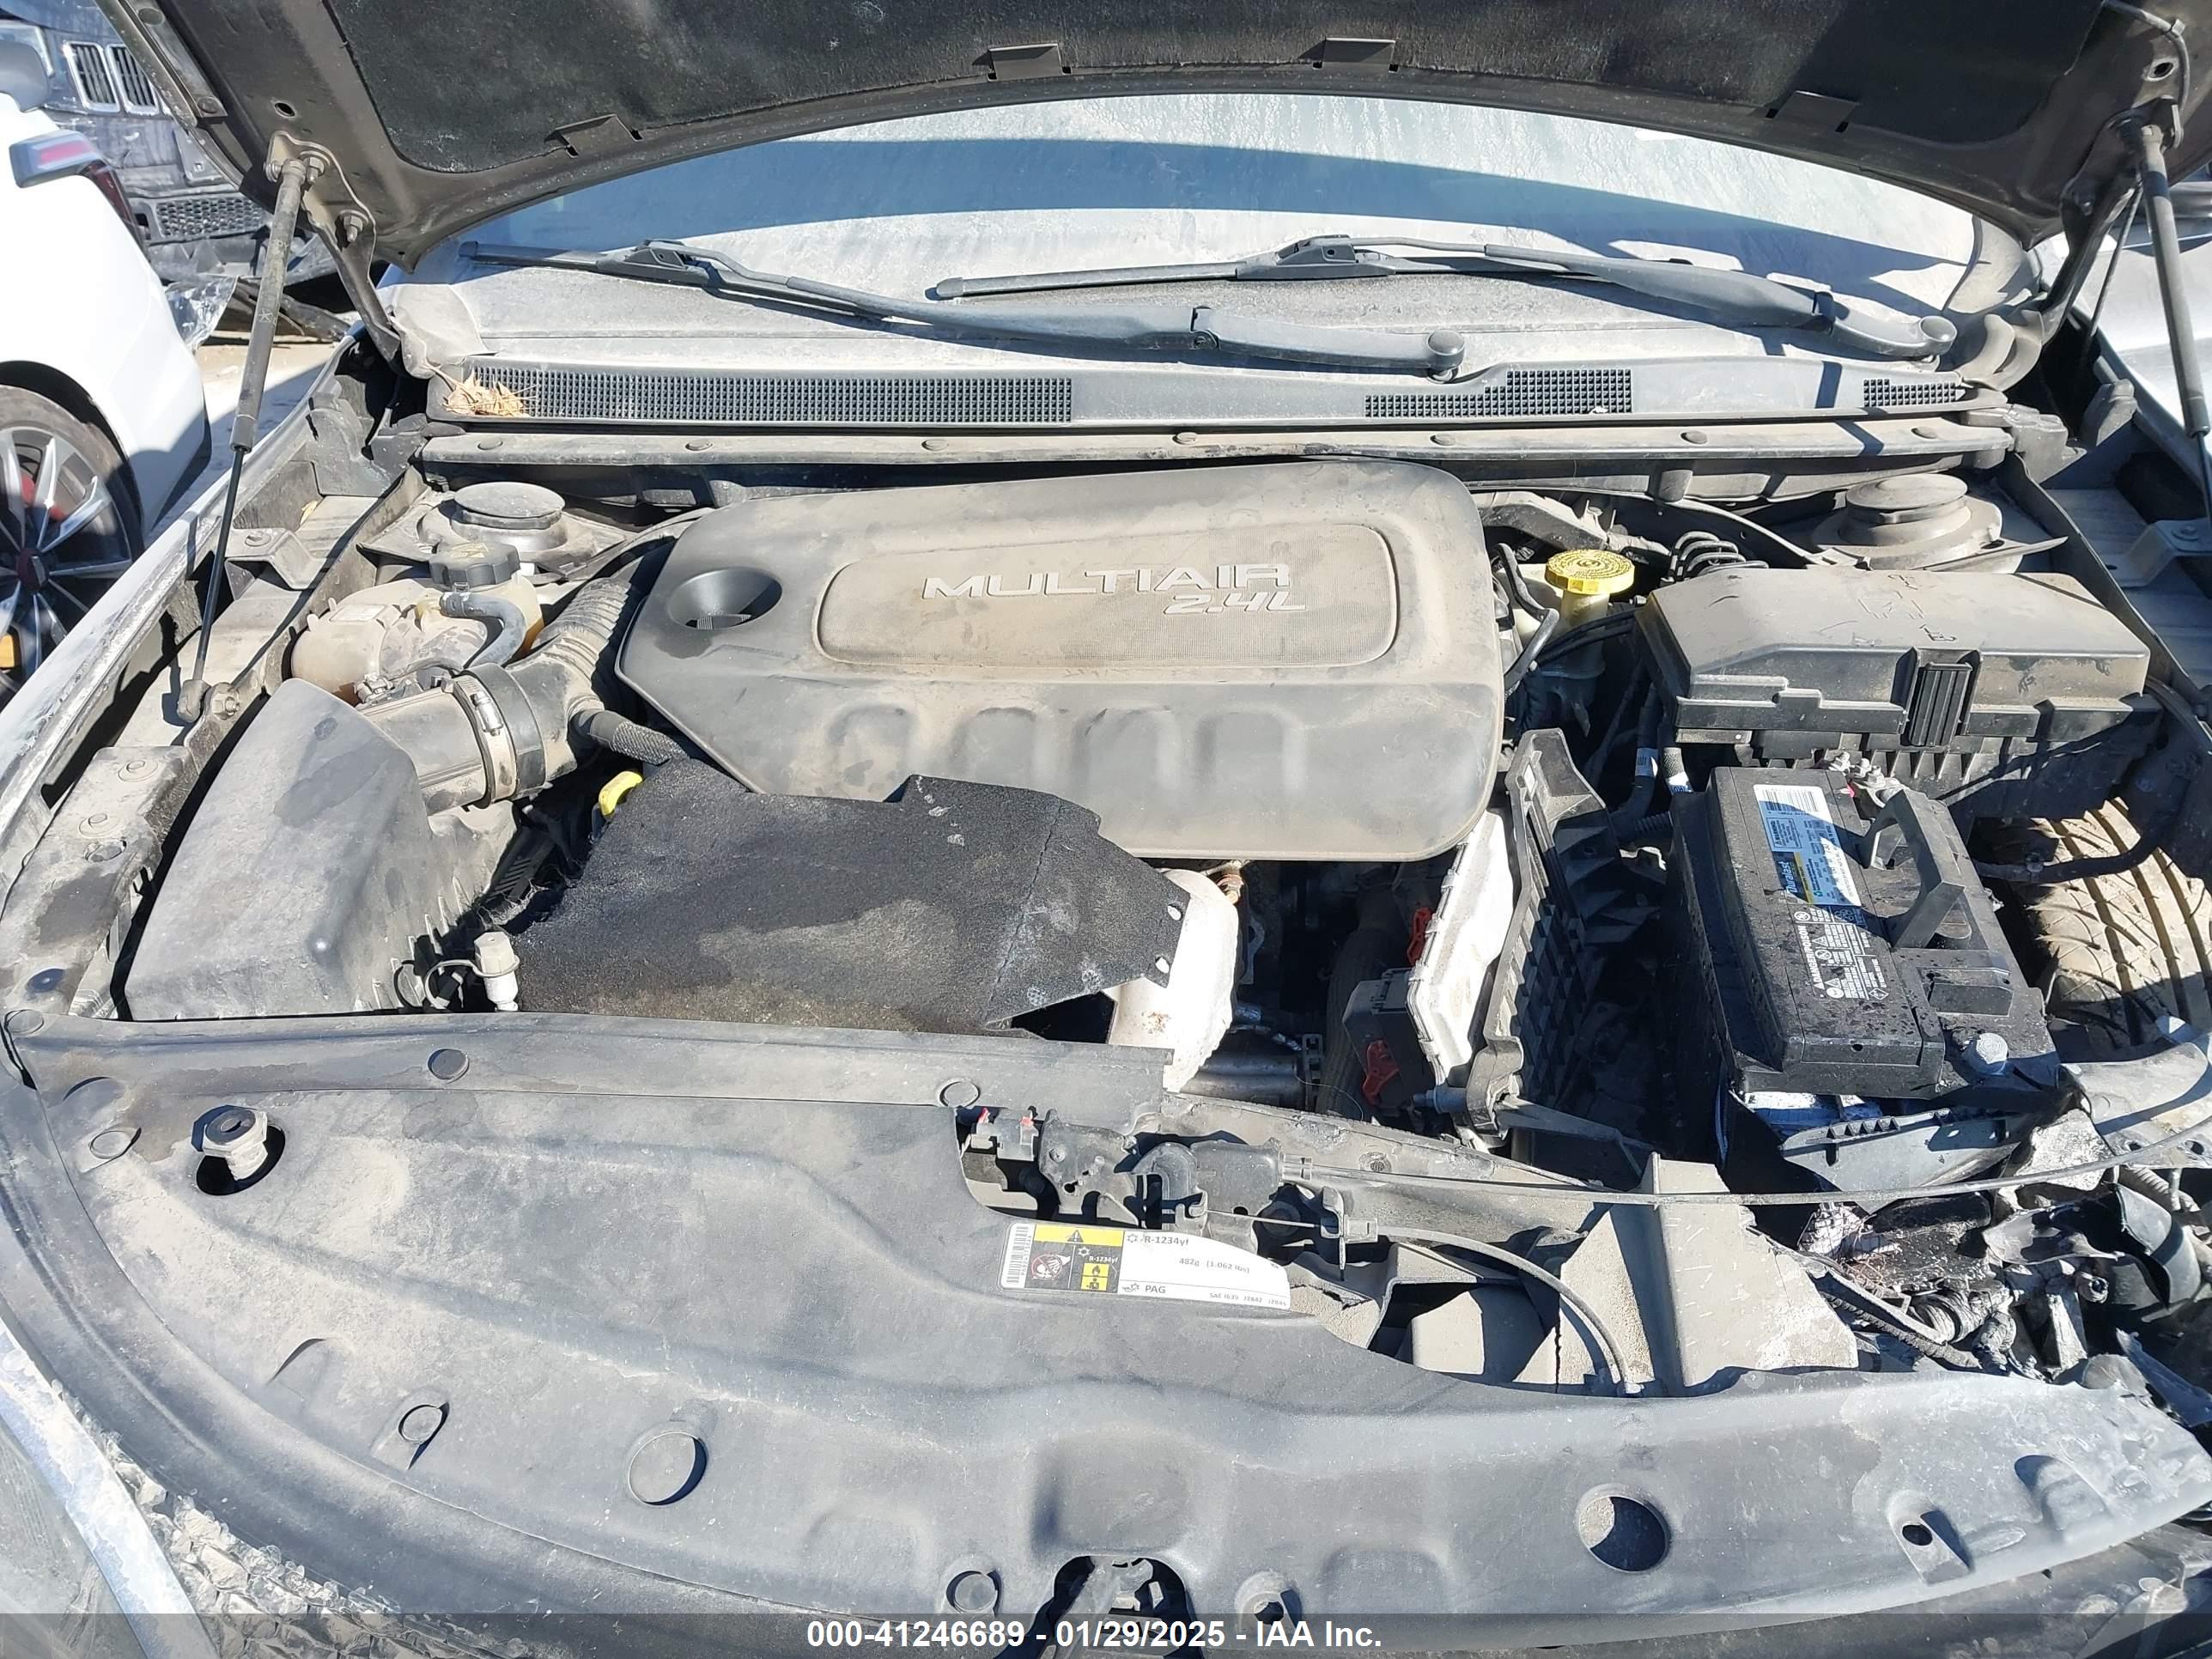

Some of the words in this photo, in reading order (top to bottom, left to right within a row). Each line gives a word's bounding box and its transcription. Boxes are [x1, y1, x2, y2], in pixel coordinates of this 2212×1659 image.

[921, 562, 1291, 600] MULTIAIR
[1163, 590, 1307, 617] 2.4L
[1778, 860, 1798, 893] Duralast
[1797, 925, 1823, 983] DANGER/POISON
[1144, 1236, 1189, 1246] R-1234yf
[1088, 1255, 1119, 1264] R-1234yf
[1179, 1257, 1200, 1267] 482g
[1145, 1285, 1166, 1294] PAG
